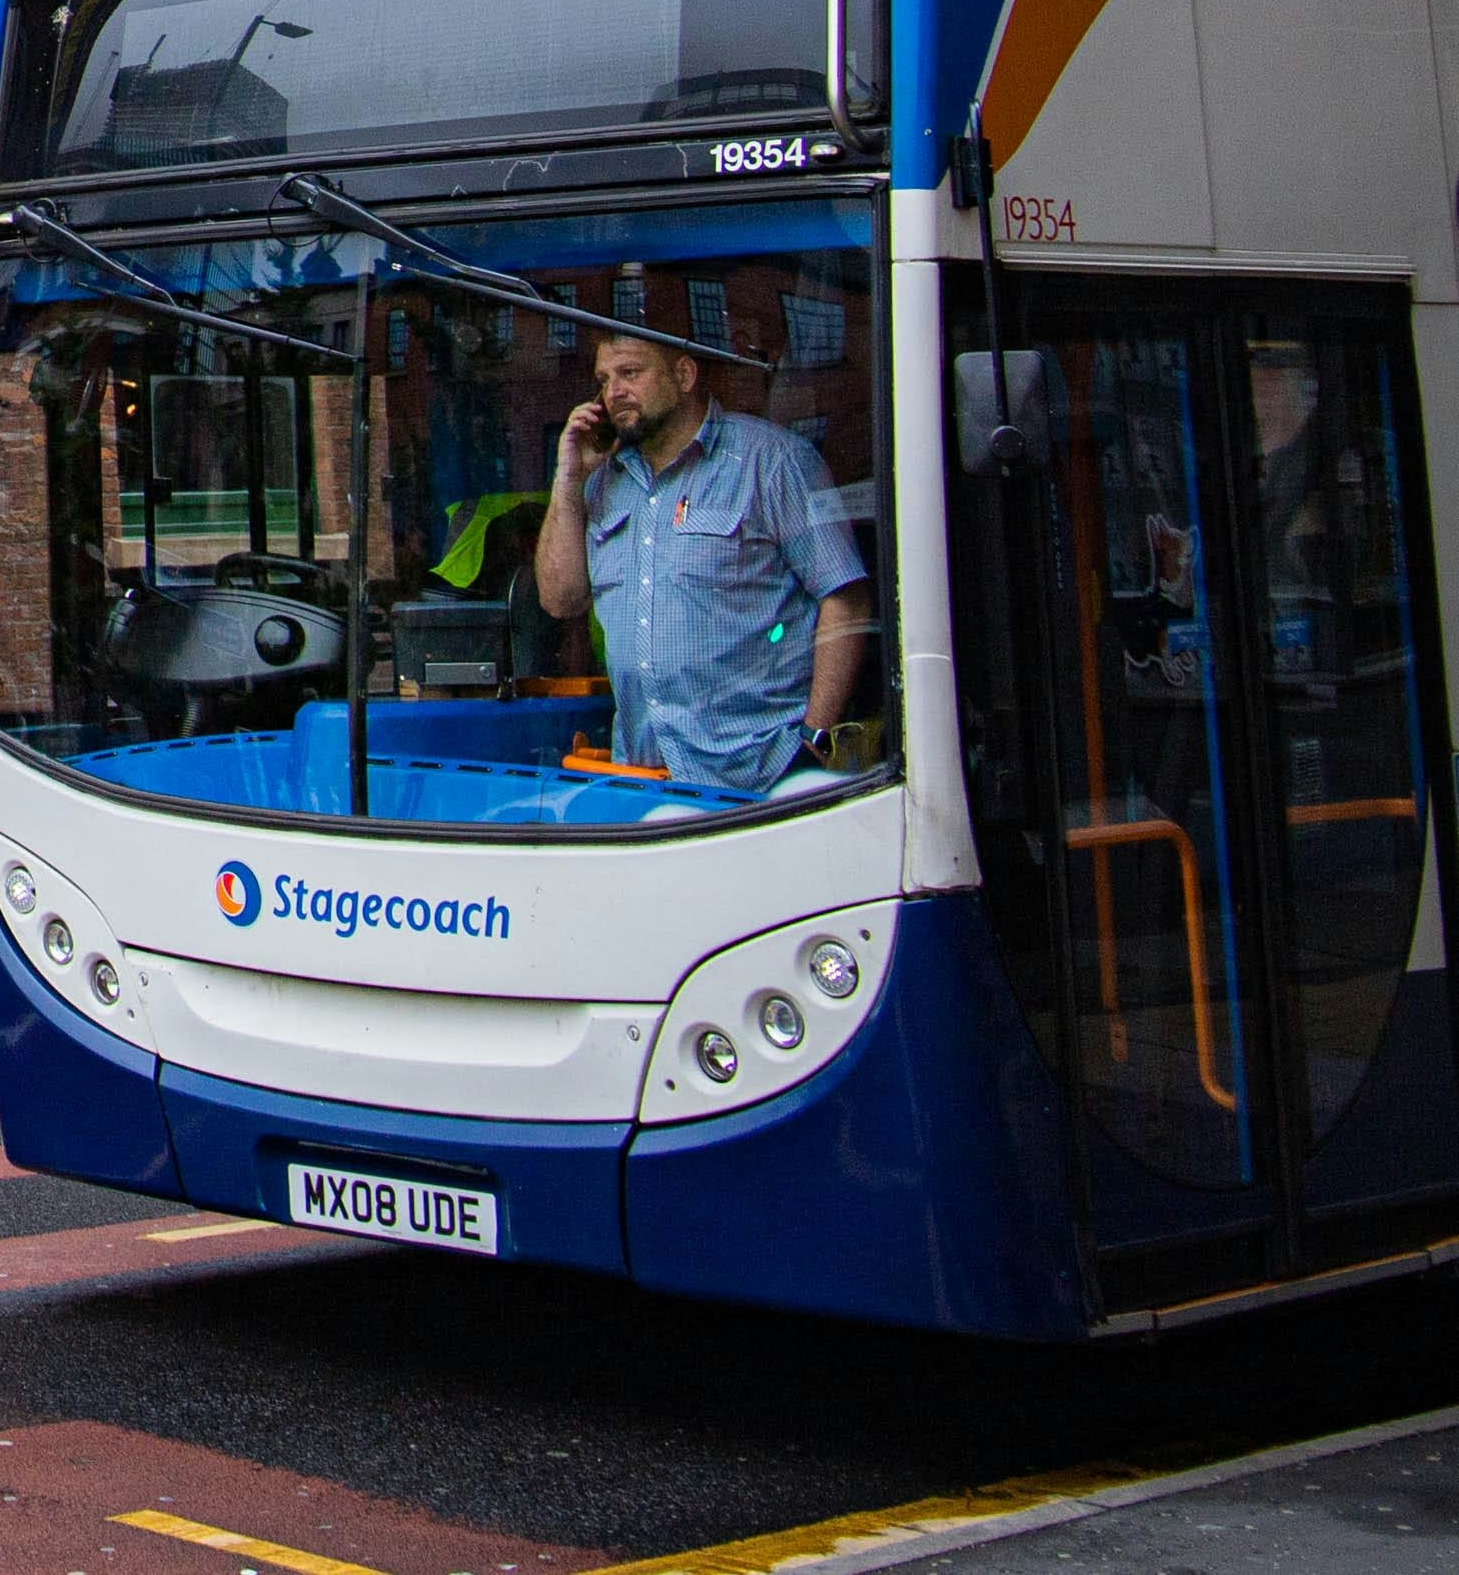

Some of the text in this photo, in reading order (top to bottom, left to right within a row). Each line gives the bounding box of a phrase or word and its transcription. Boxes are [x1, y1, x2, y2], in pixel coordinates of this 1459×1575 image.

[709, 137, 807, 173] 19354
[1003, 196, 1077, 242] 19354
[272, 873, 511, 940] Stagecoach
[303, 1171, 482, 1242] MX08 UDE
